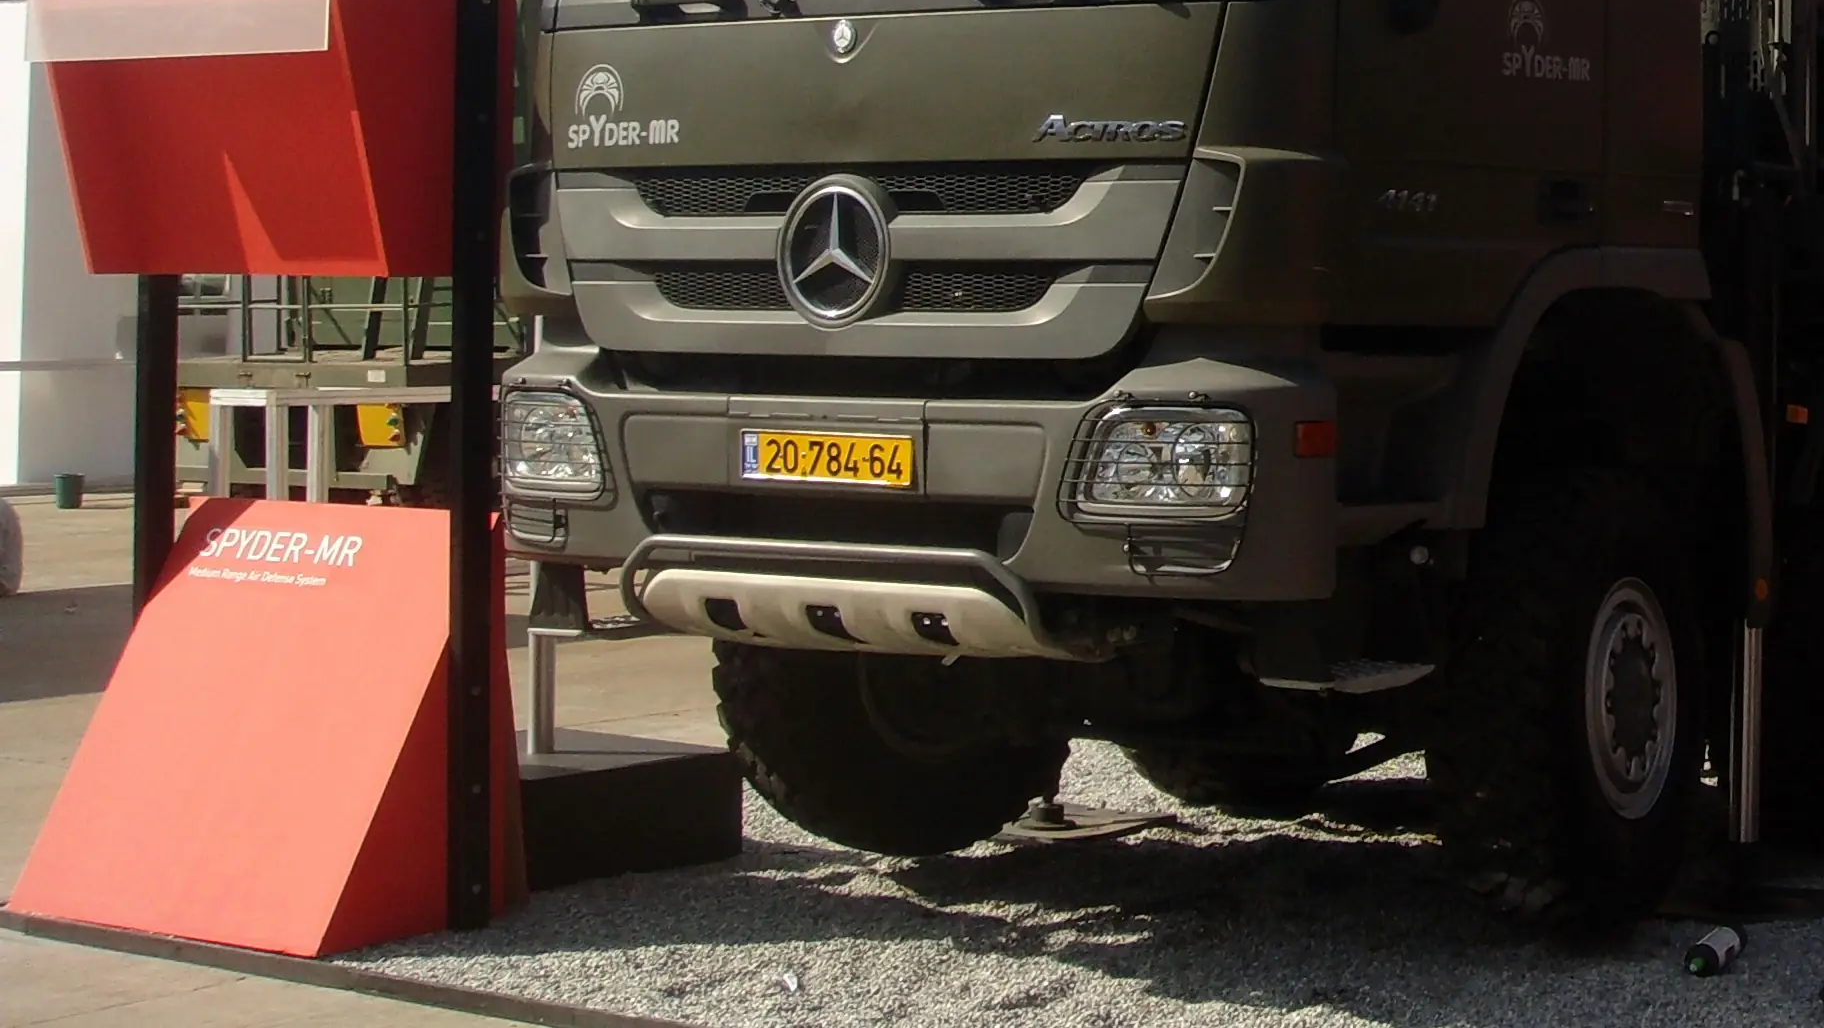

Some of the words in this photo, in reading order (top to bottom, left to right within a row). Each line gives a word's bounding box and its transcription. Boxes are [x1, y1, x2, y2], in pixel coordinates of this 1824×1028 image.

[1502, 44, 1591, 81] SPYDER-MR
[567, 114, 680, 149] SPYDER-MR
[199, 528, 363, 567] SPYDER-MR
[221, 568, 247, 583] Range
[247, 571, 261, 581] Air
[260, 572, 295, 584] Defense
[294, 574, 327, 587] System
